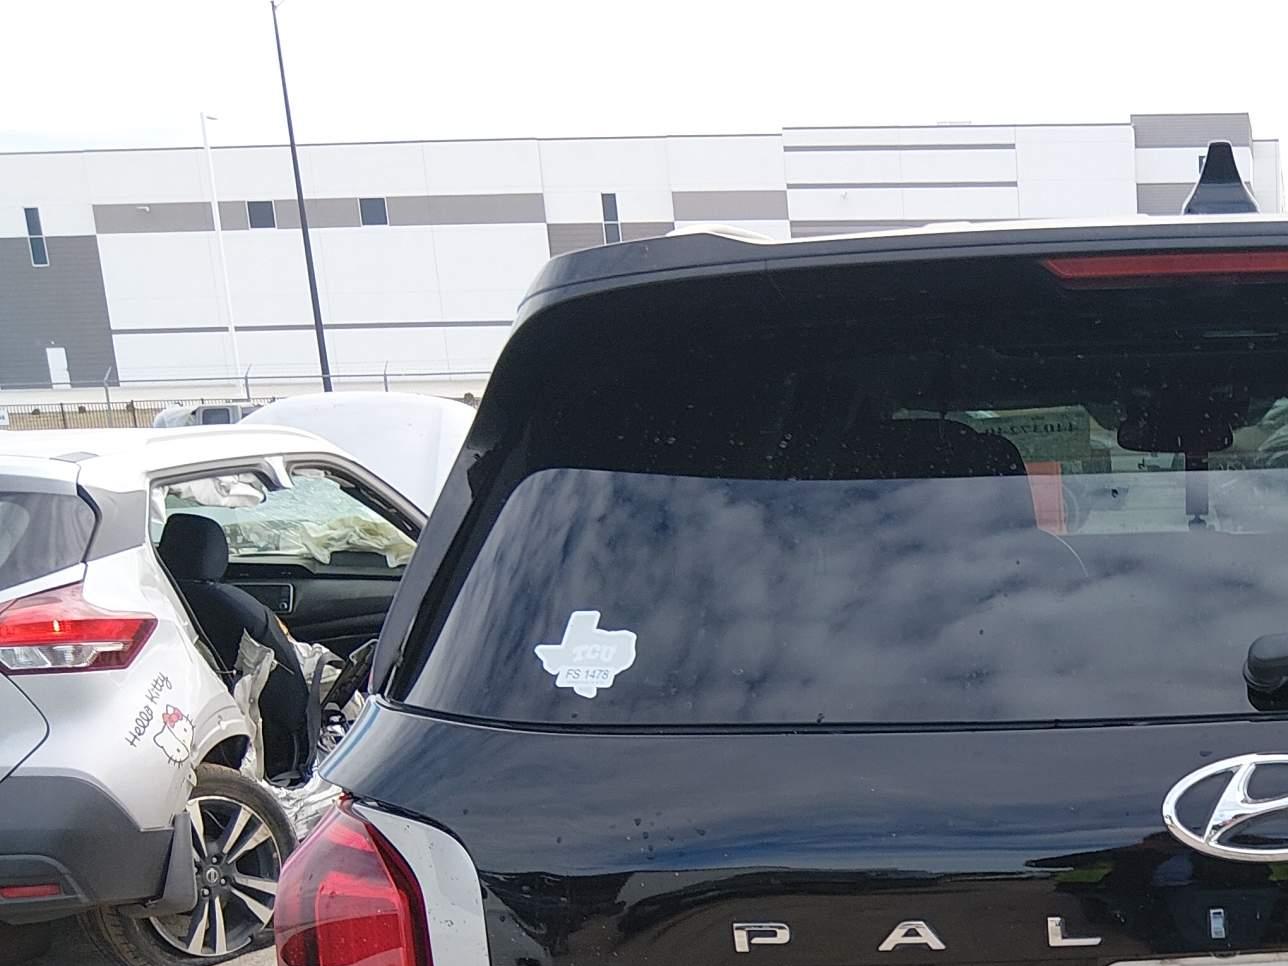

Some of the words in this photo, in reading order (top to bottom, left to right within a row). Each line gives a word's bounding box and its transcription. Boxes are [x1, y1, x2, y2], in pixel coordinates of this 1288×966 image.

[565, 668, 581, 680] FS
[125, 704, 154, 747] Hello
[145, 672, 172, 705] Kitty
